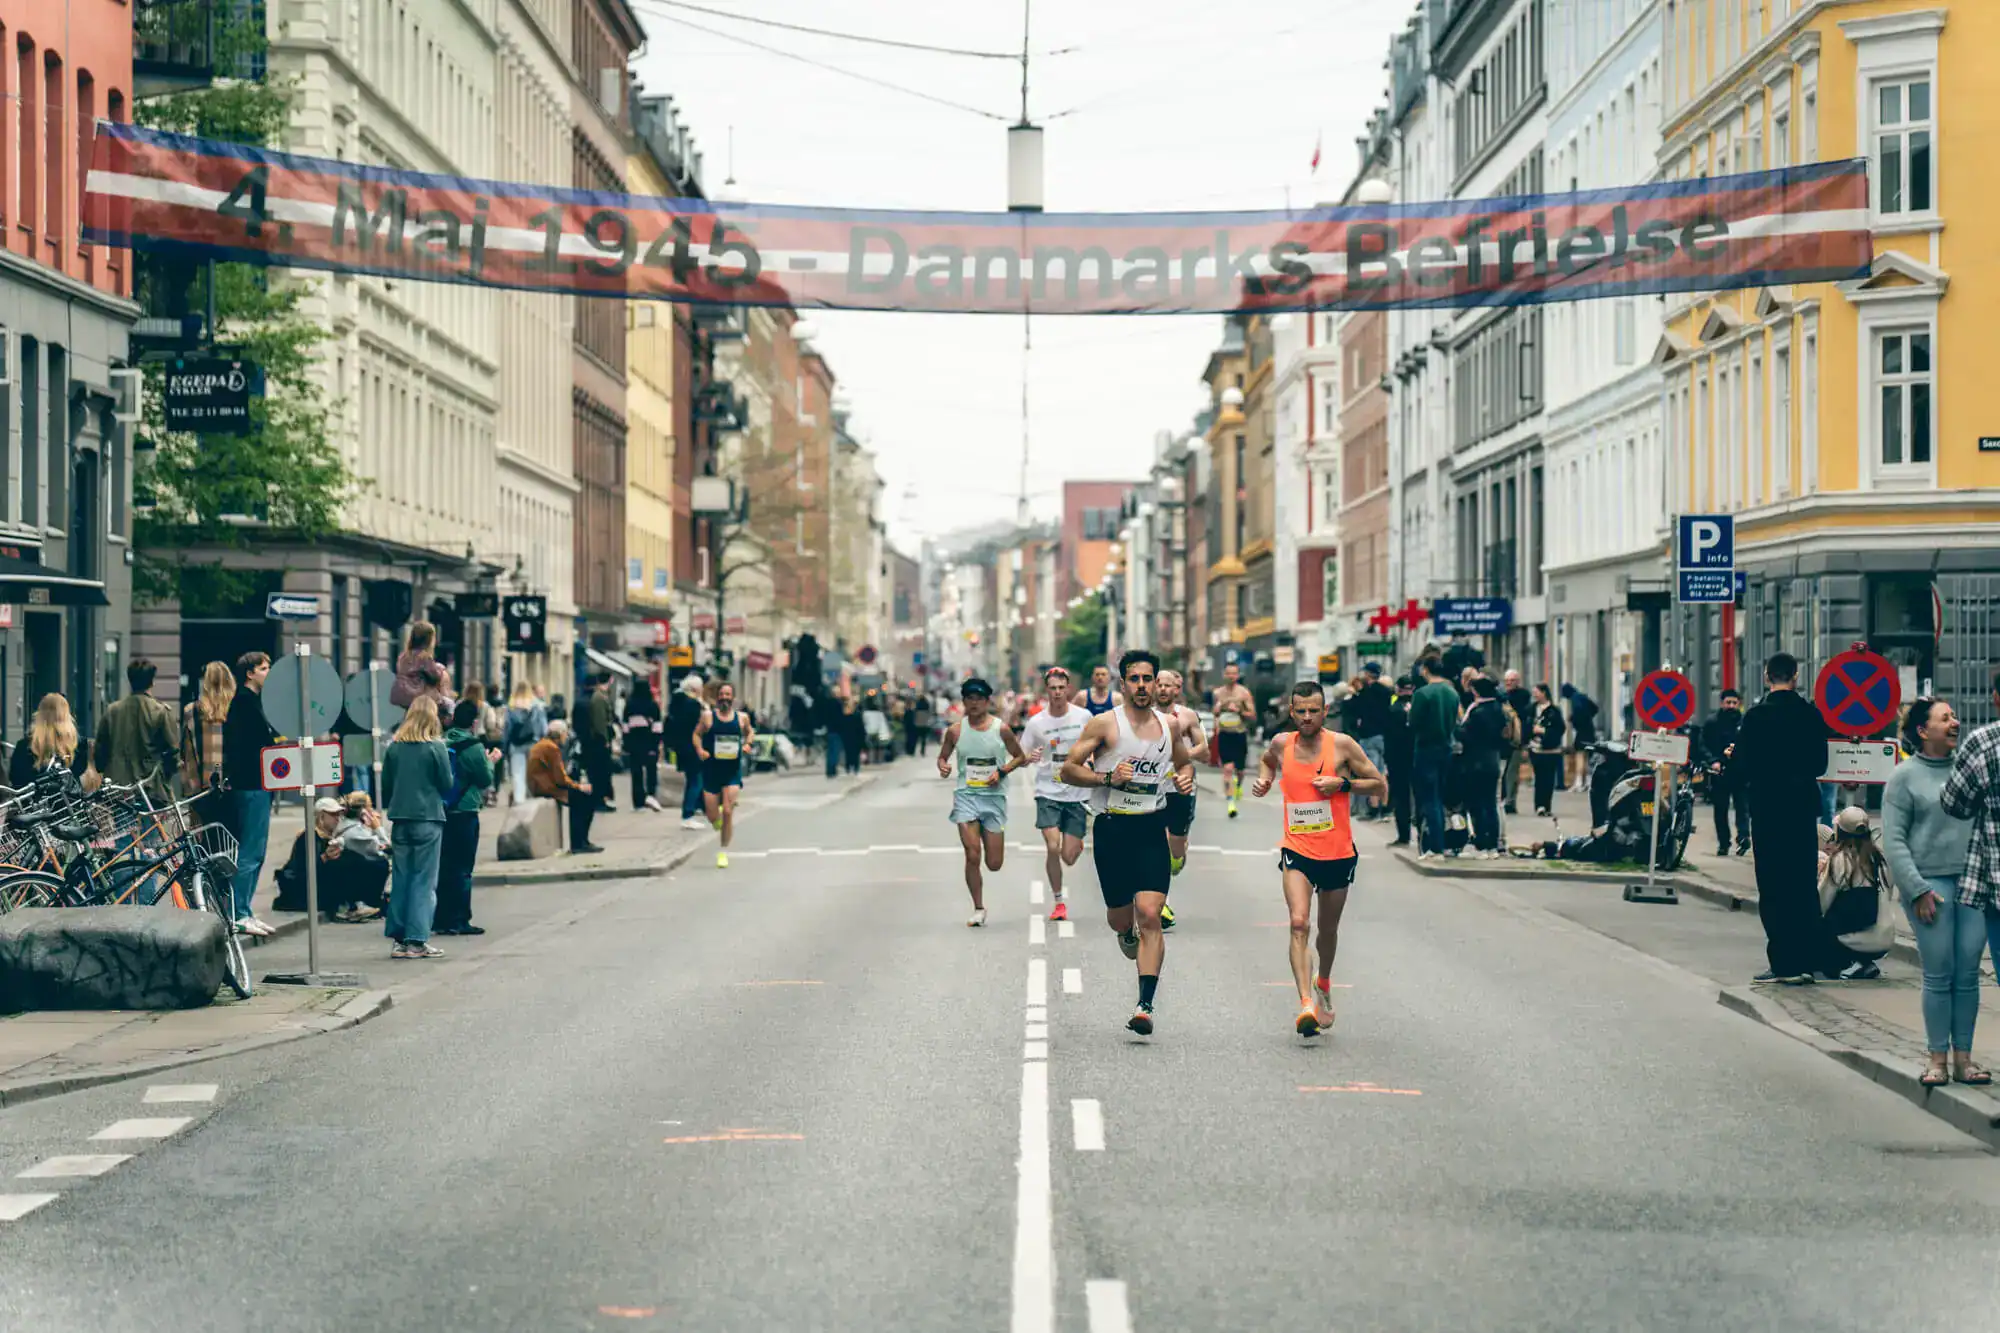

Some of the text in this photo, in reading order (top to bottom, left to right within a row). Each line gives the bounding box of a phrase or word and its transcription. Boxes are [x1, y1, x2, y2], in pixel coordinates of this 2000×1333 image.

[526, 205, 762, 287] 1945
[846, 226, 1314, 298] Danmarks
[1346, 205, 1730, 291] Befrielse
[1691, 521, 1721, 563] P
[1708, 554, 1728, 562] info
[1130, 759, 1160, 774] ICK
[1294, 807, 1323, 817] Rasmus
